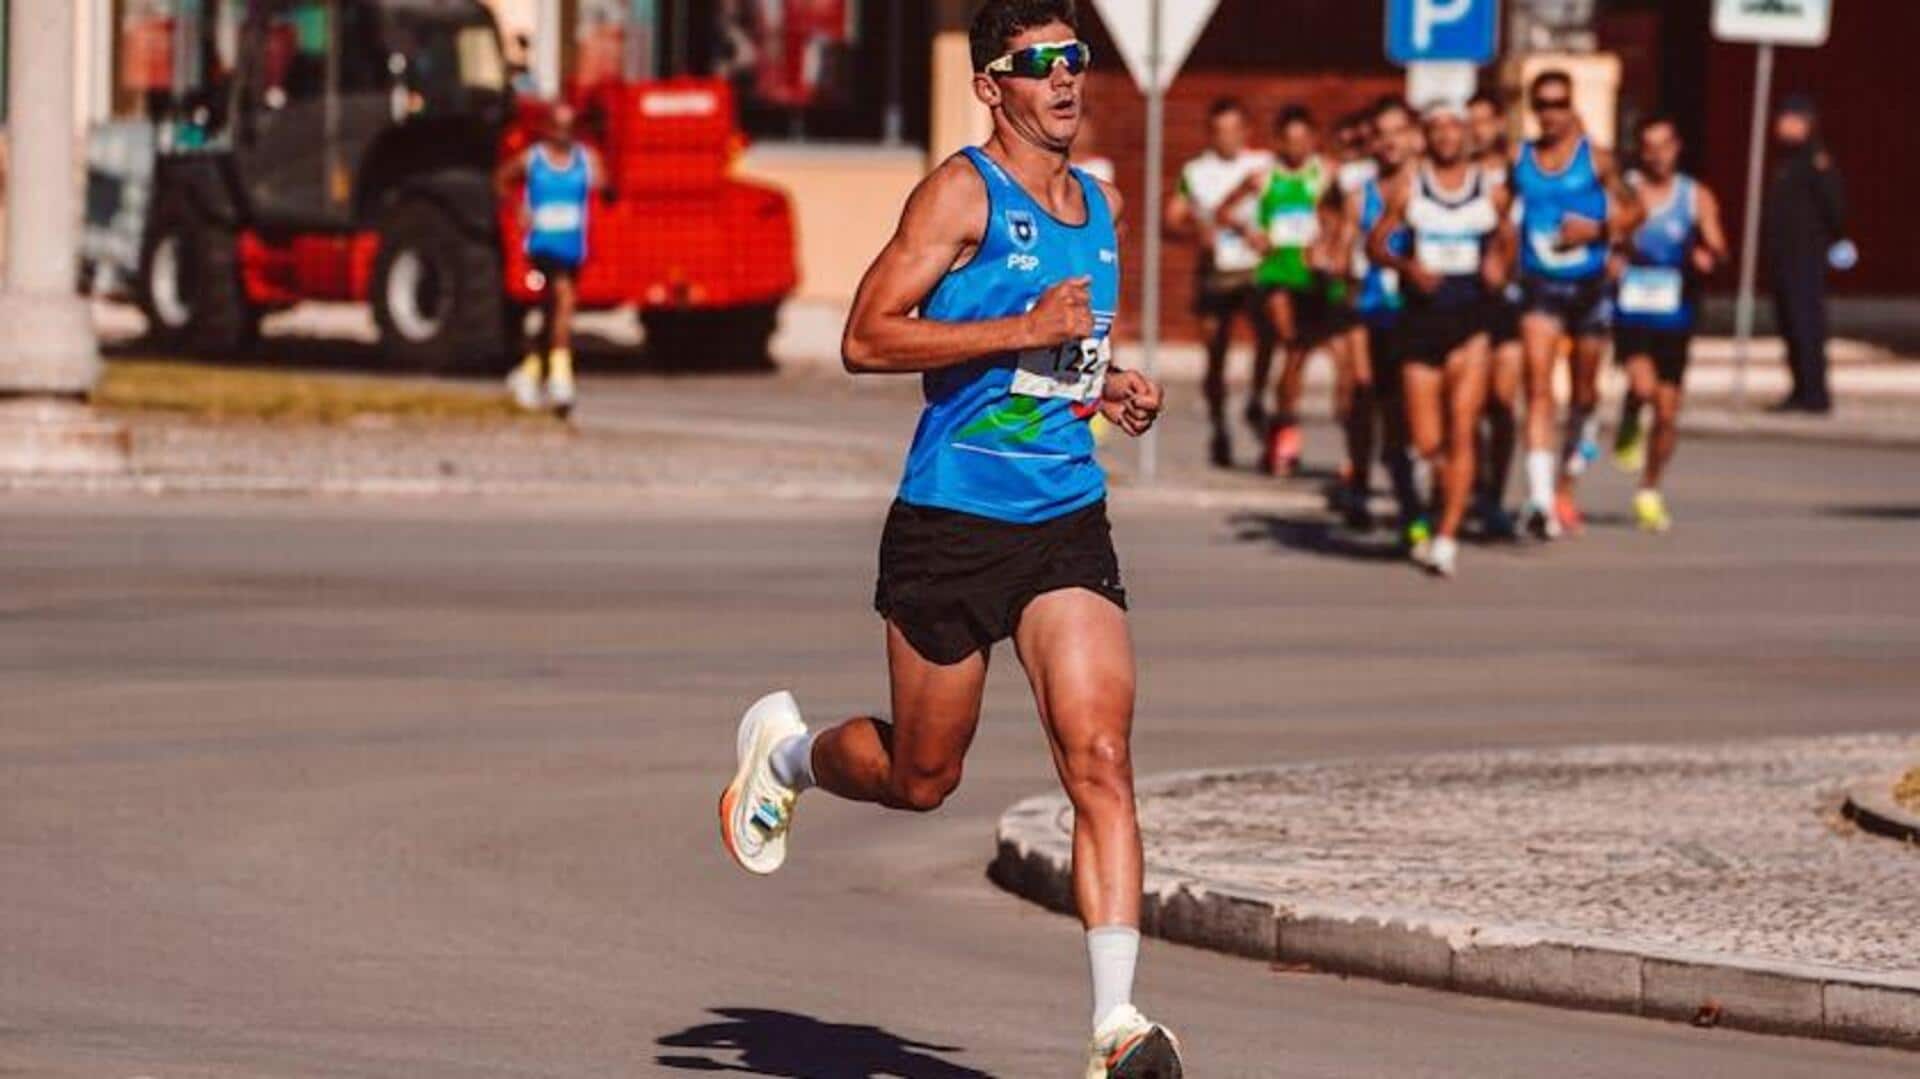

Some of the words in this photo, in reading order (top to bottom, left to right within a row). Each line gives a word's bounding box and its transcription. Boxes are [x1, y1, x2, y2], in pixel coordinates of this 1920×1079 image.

[1413, 0, 1473, 49] P
[1007, 253, 1040, 271] PSP
[1051, 344, 1098, 374] 122
